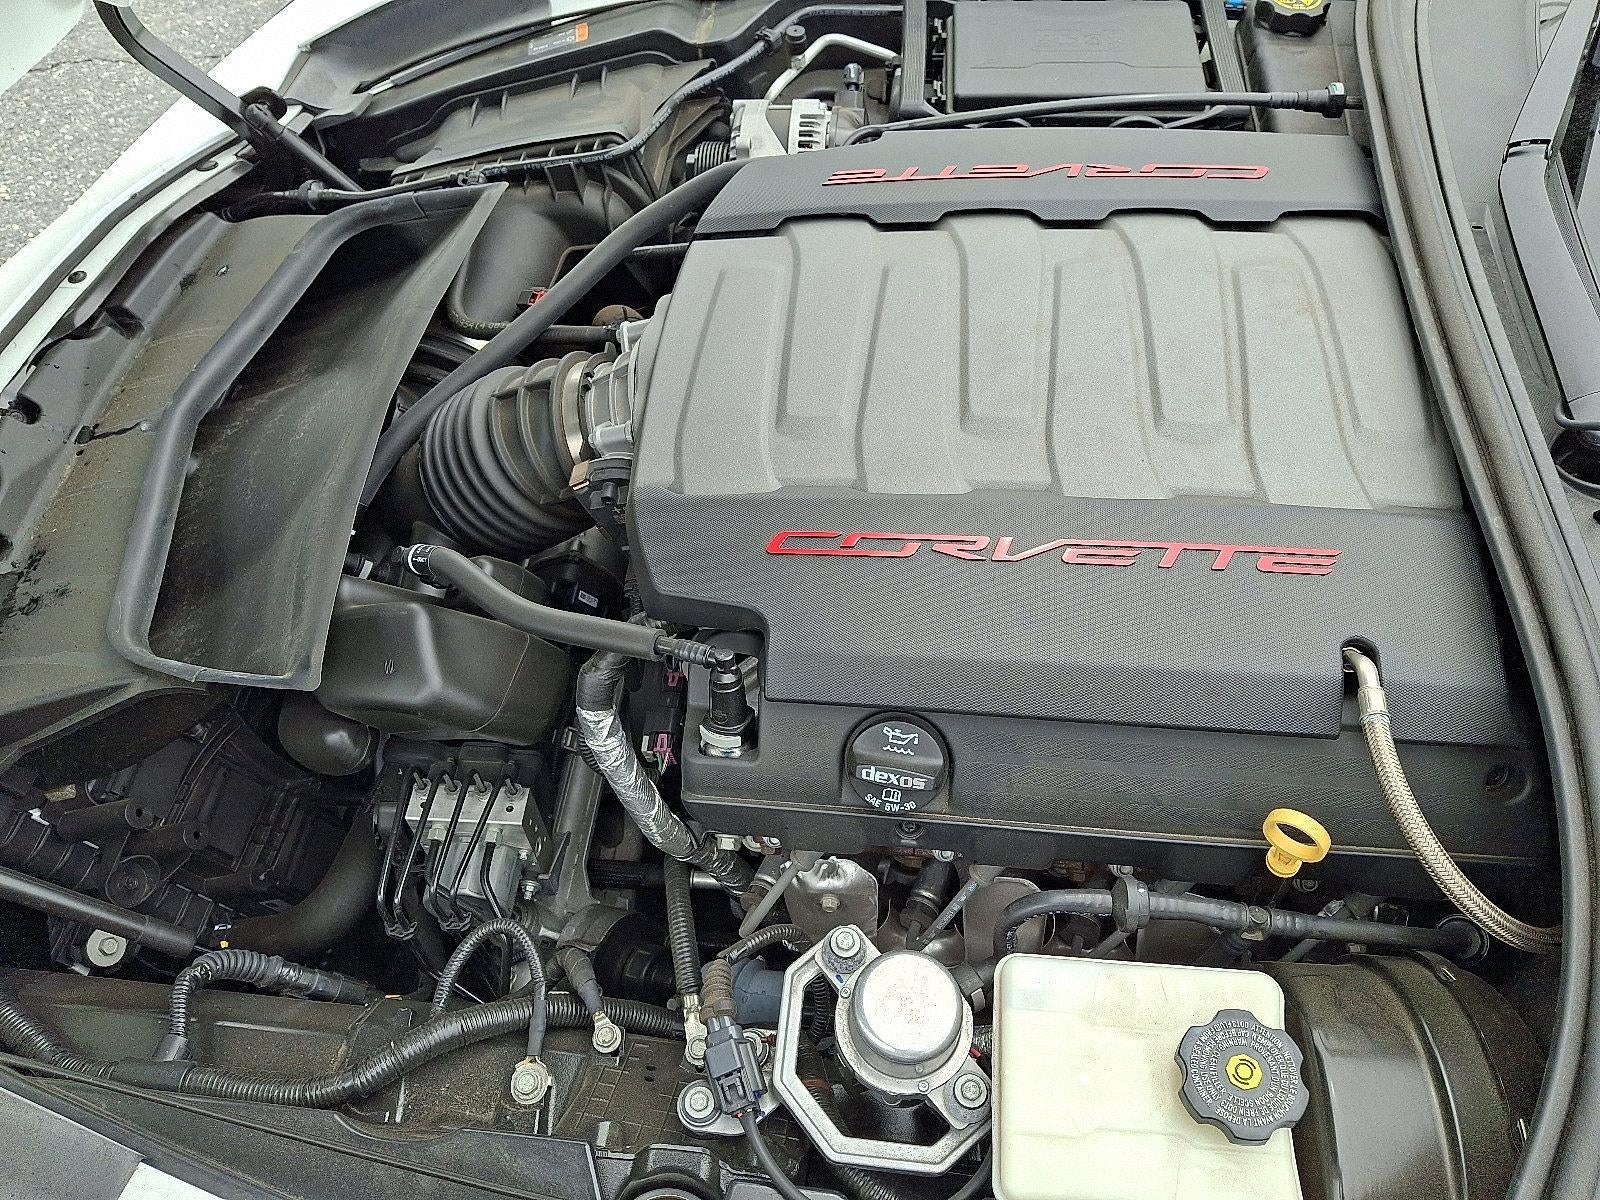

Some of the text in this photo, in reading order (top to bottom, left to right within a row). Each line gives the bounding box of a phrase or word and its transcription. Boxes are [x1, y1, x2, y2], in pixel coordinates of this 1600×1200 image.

[822, 163, 1270, 187] CORVETTE
[765, 530, 1343, 576] CORVETTE
[861, 766, 928, 790] dexos
[864, 793, 916, 812] SAE 5W-30
